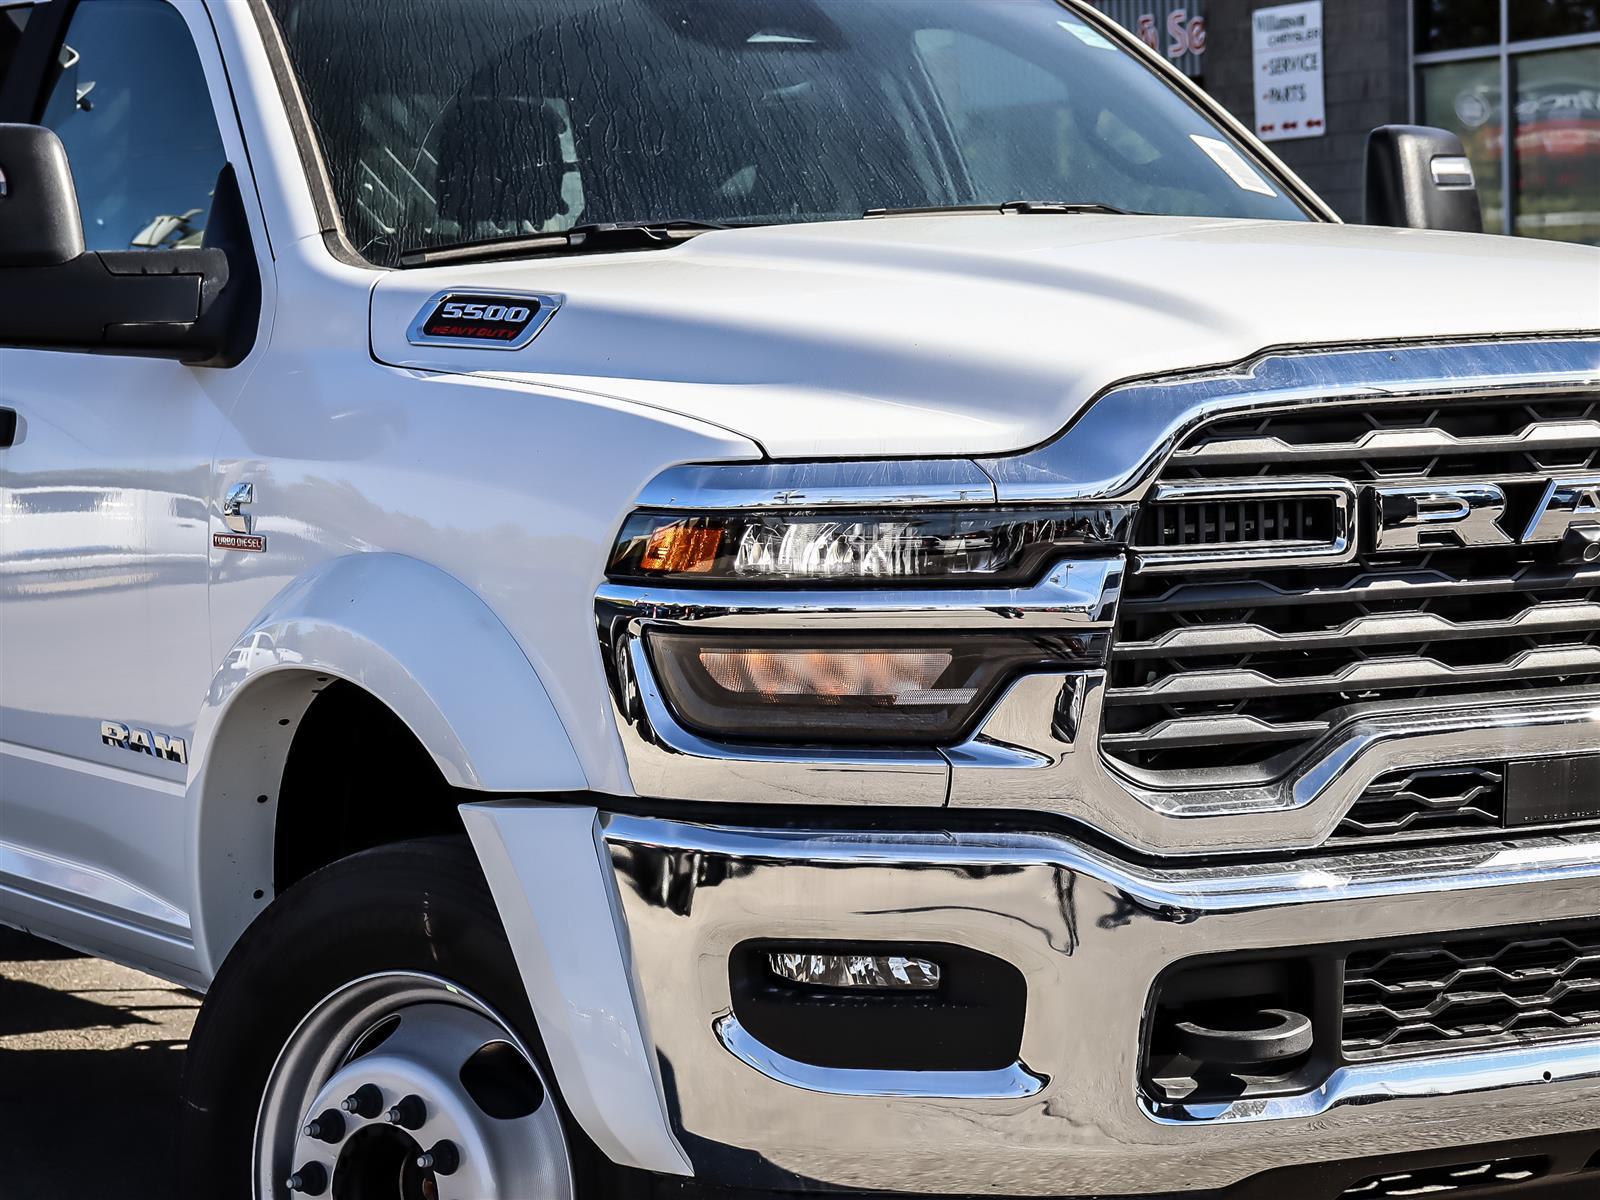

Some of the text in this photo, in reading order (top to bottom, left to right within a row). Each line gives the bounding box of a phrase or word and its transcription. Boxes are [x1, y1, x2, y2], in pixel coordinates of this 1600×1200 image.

[1269, 52, 1318, 76] SERVICE
[1269, 84, 1307, 103] PARTS
[441, 302, 531, 323] 5500
[431, 325, 519, 338] HEAVY DUTY
[214, 536, 262, 548] TURBO DIESEL
[101, 719, 188, 764] RAM
